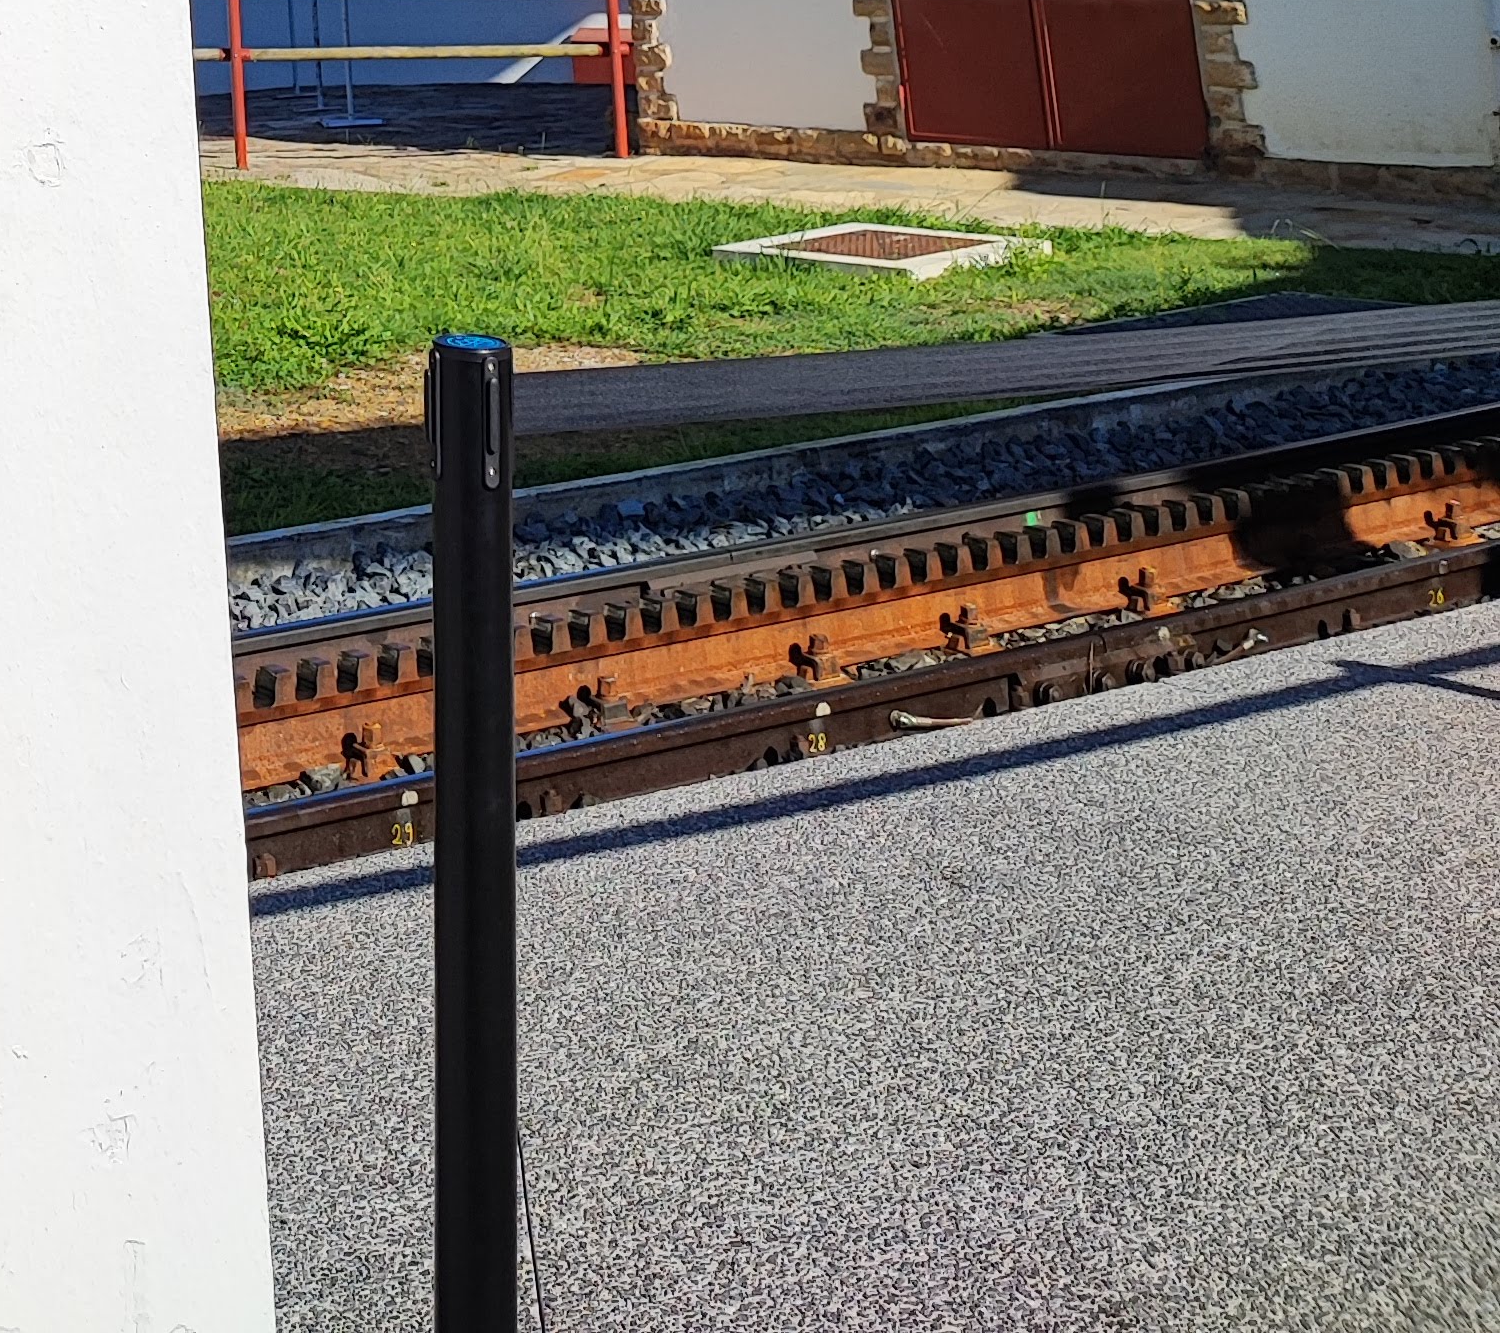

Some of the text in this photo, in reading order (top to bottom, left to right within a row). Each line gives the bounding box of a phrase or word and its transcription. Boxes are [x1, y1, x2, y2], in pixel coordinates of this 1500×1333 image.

[1427, 587, 1445, 608] 26
[808, 732, 827, 753] 28
[391, 822, 414, 847] 29
